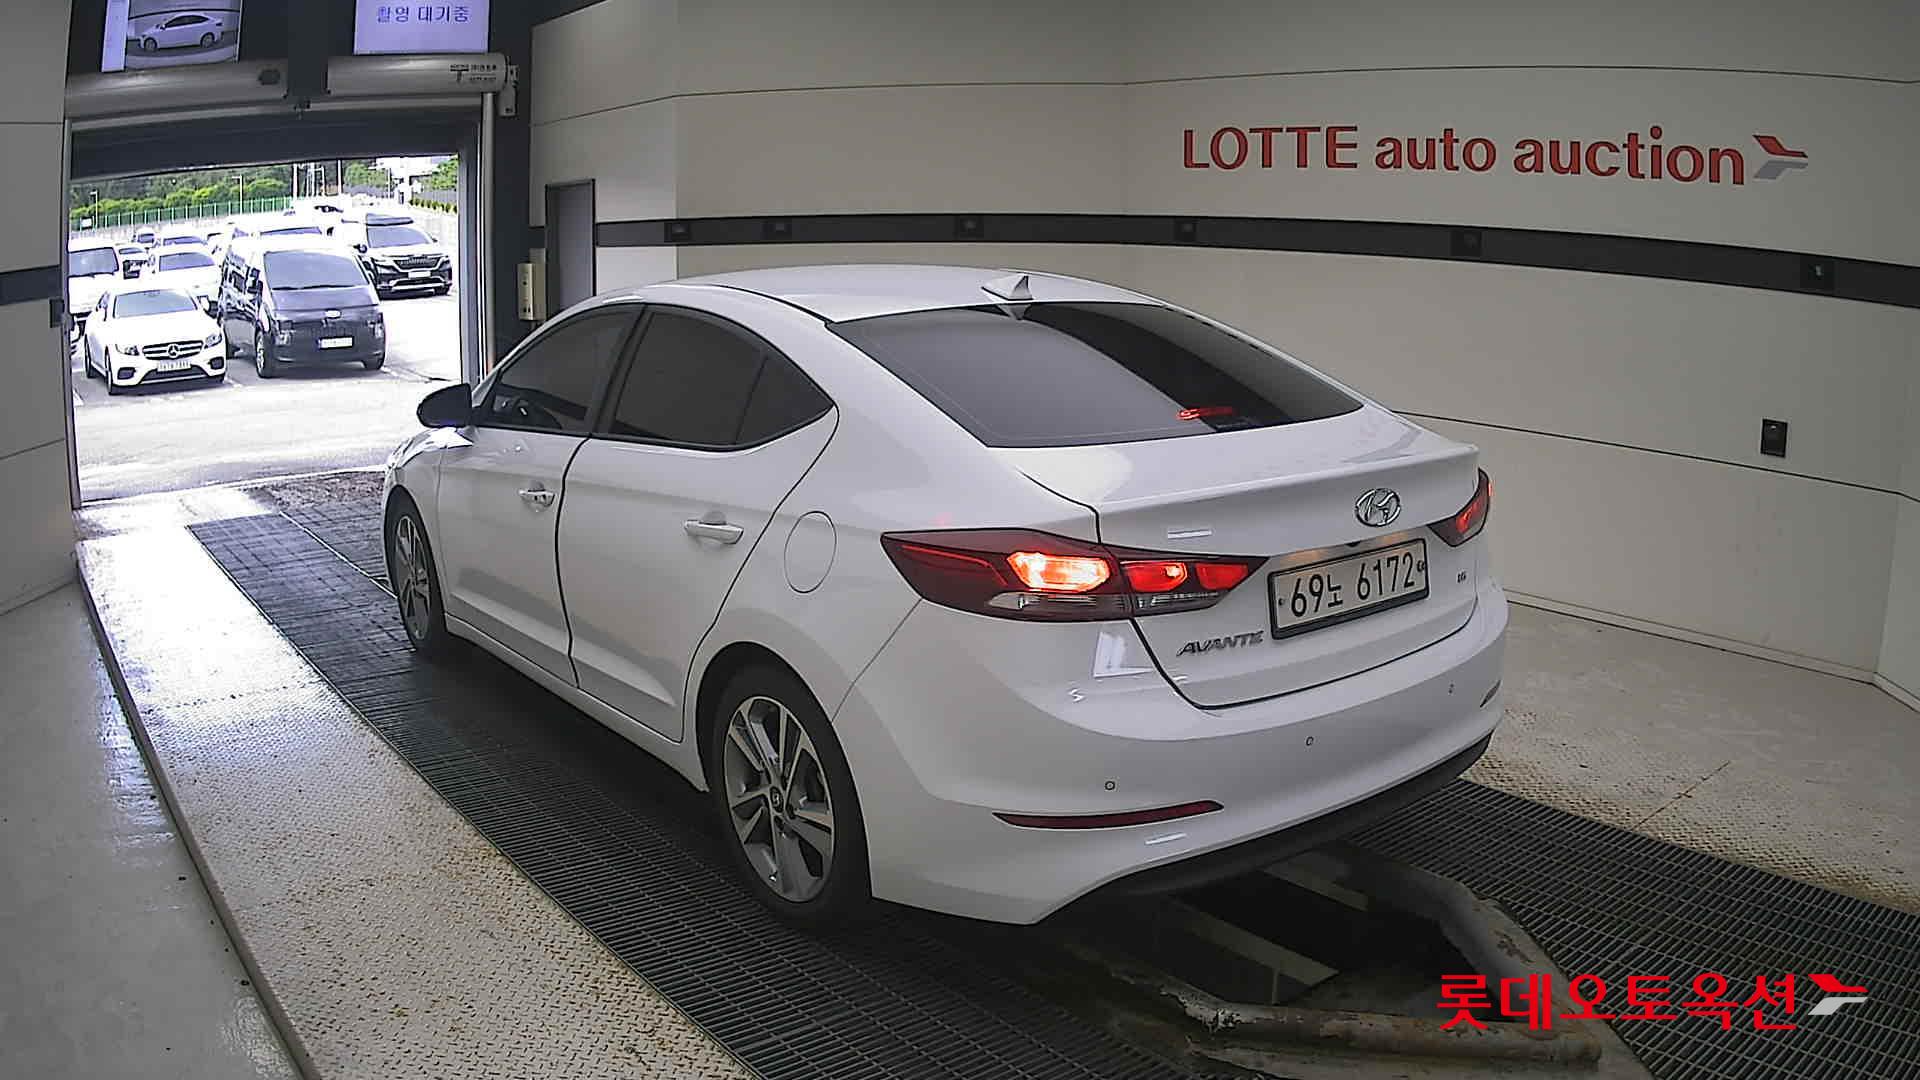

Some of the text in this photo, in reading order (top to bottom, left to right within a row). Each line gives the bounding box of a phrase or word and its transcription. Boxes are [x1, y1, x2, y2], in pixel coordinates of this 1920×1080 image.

[417, 5, 469, 23] 대기중
[1183, 125, 1745, 185] LOTTE auto auction
[1291, 551, 1415, 617] 69노 6172
[1176, 629, 1264, 657] AVANTE
